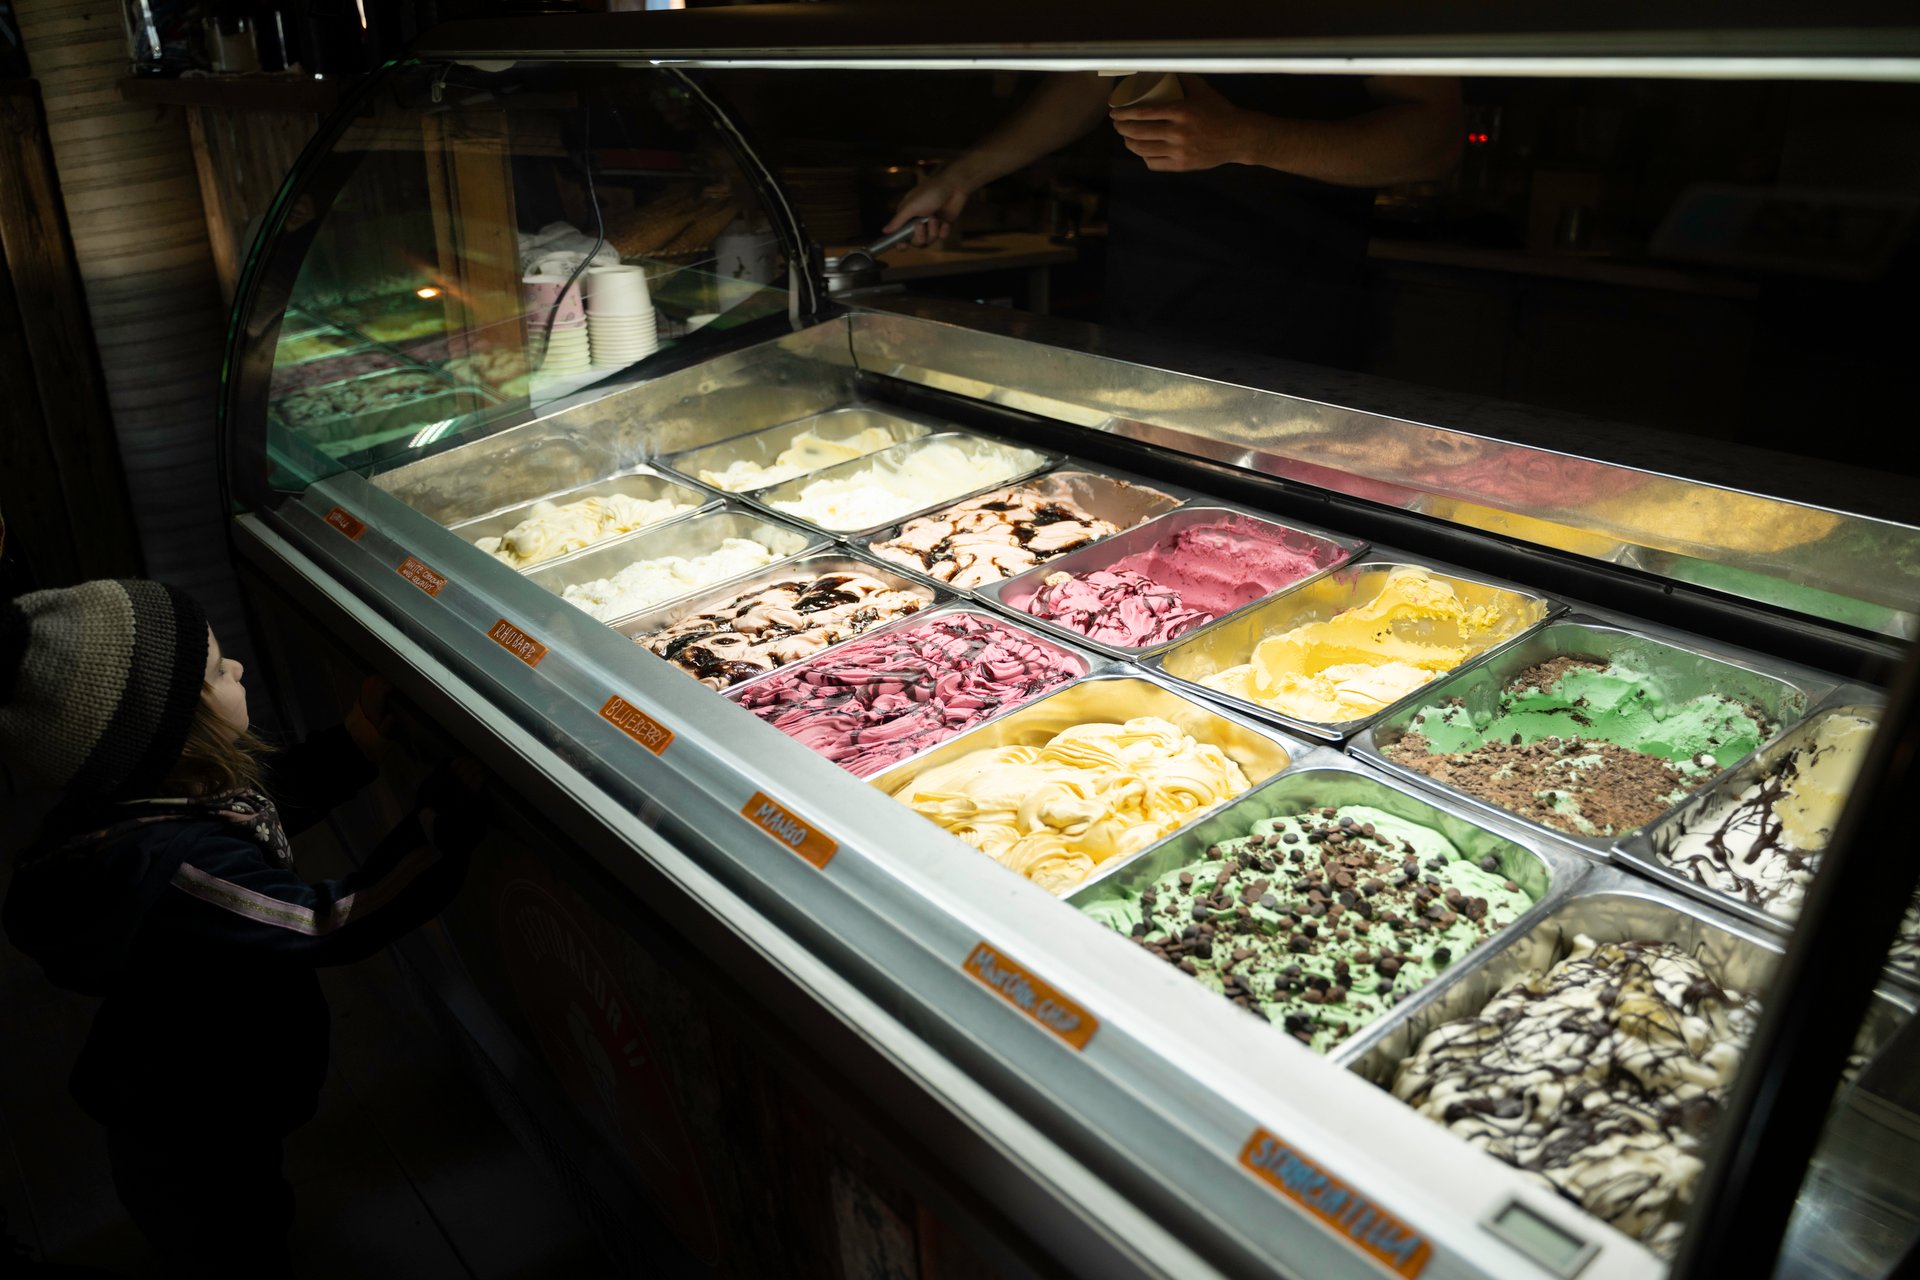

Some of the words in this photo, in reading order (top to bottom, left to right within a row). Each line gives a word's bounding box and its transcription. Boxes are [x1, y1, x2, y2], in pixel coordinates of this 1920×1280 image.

[494, 623, 536, 660] RHUBARB
[605, 698, 667, 746] BLUEBERRY
[754, 801, 808, 846] MANGO
